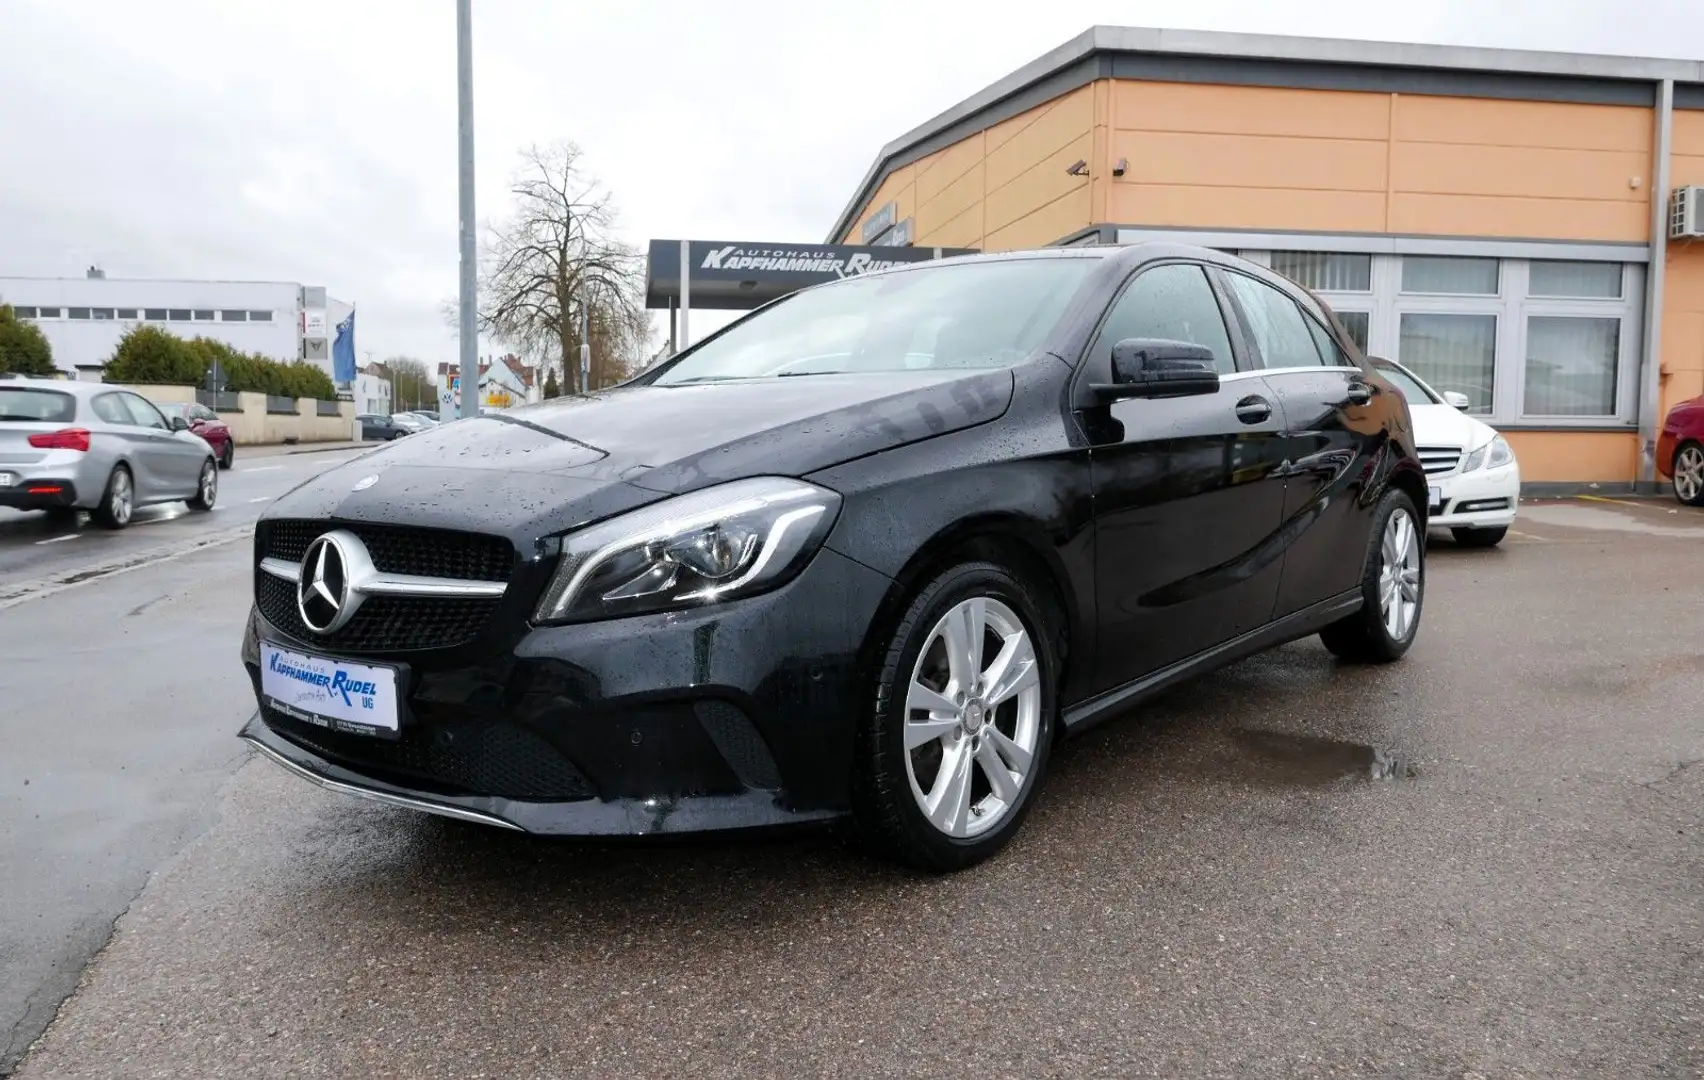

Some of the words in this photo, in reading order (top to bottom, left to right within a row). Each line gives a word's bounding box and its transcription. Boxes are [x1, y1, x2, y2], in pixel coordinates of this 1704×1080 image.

[700, 246, 845, 279] KAPFHAMMER
[733, 248, 836, 259] AUTOHAUS
[278, 656, 326, 674] AUTOHAUS
[269, 652, 335, 698] KAPFHAMMER
[332, 669, 377, 707] RUDEL
[361, 696, 374, 710] UG
